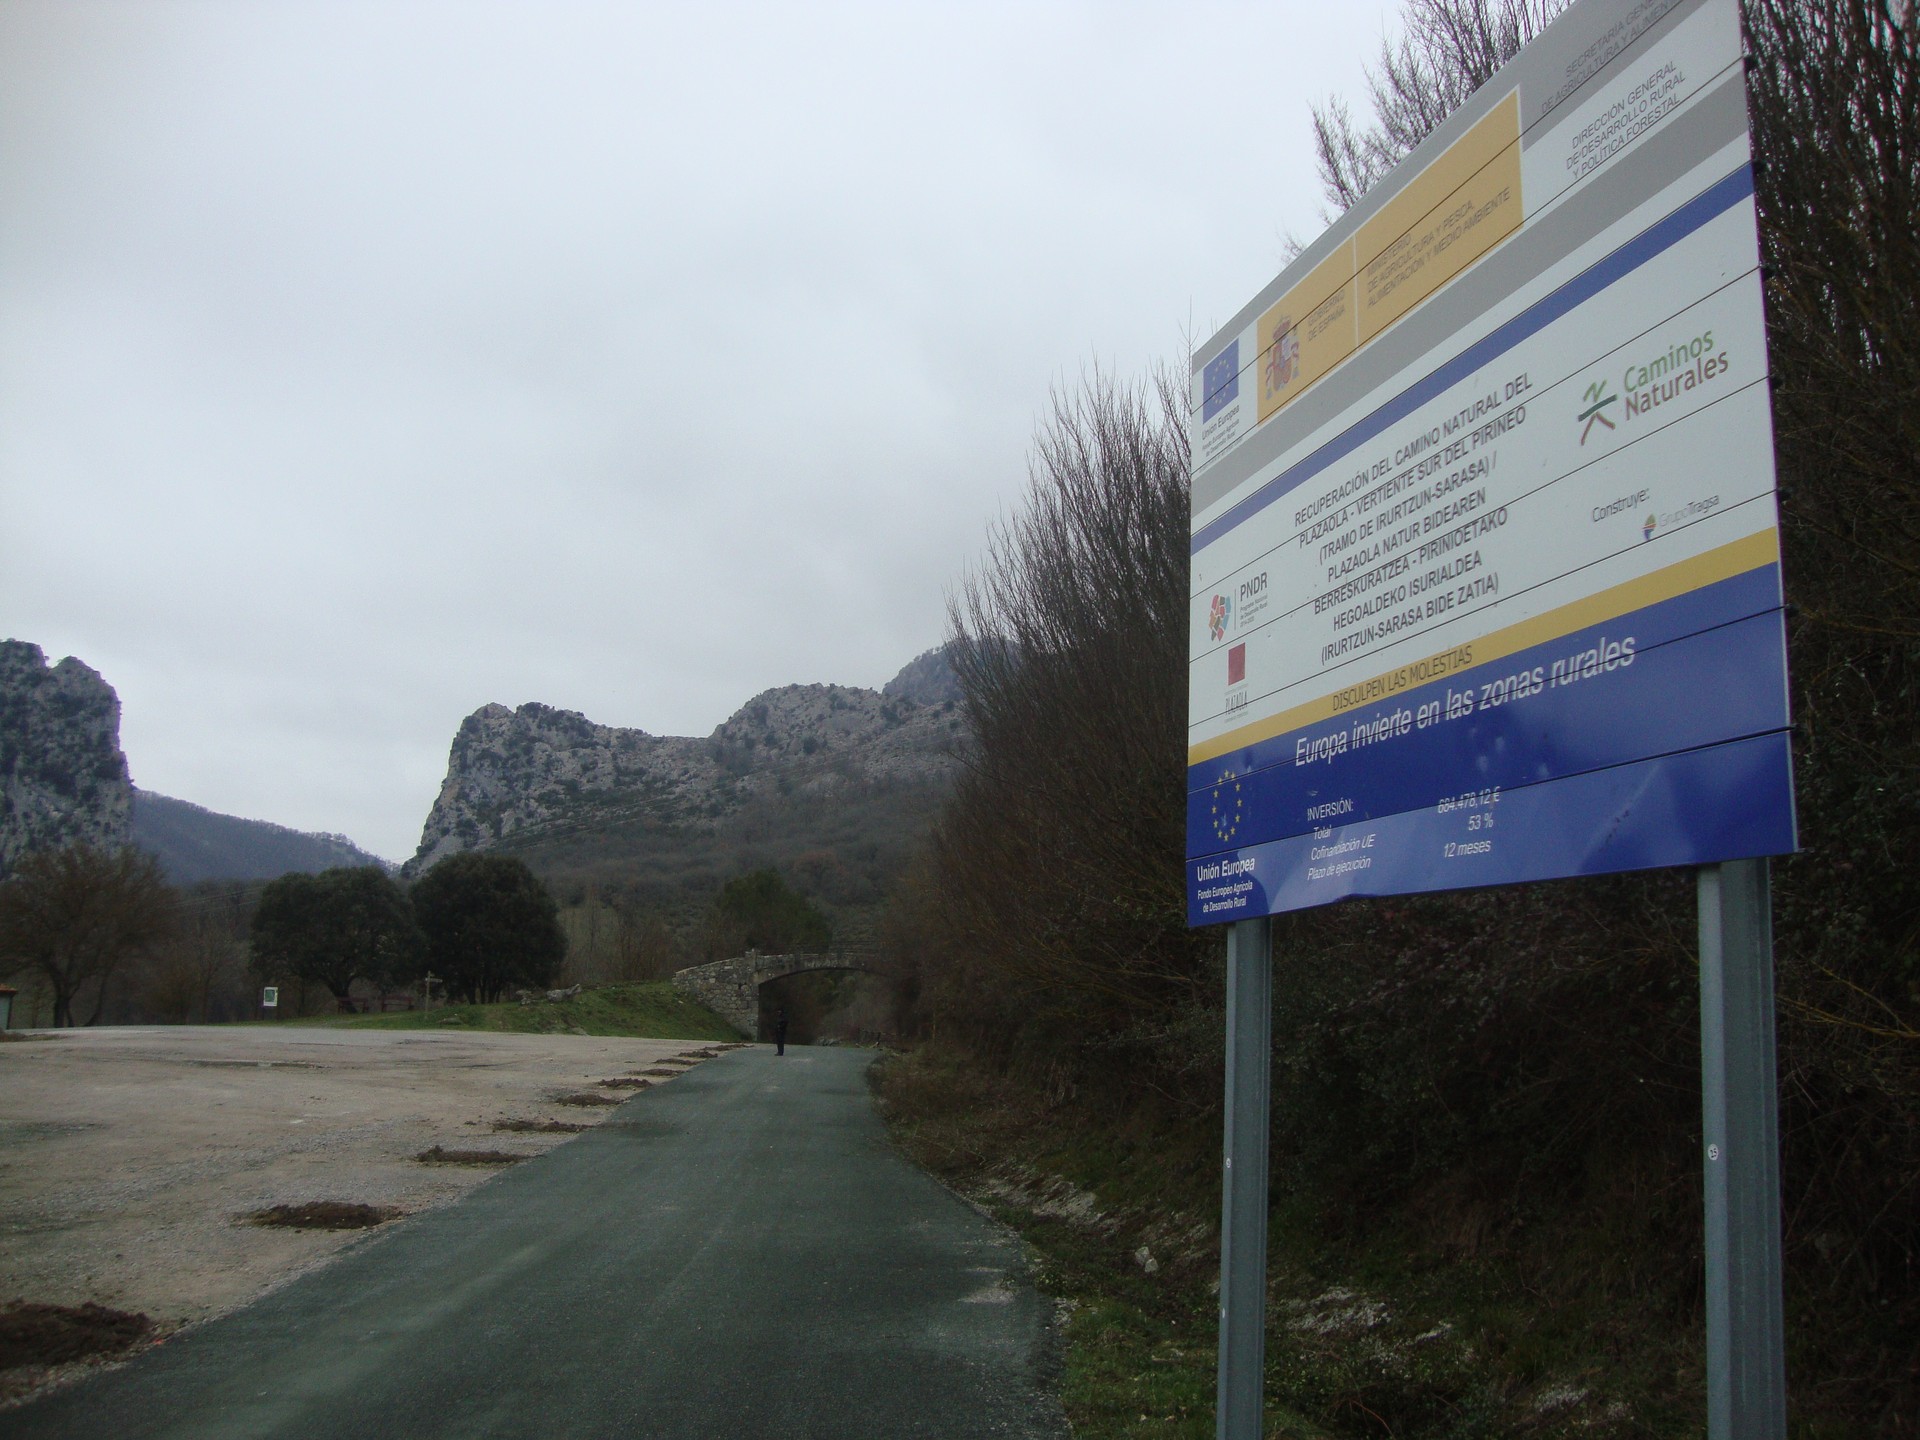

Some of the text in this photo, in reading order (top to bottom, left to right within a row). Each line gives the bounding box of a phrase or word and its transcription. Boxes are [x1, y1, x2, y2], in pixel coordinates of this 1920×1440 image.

[1541, 97, 1553, 114] DE
[1566, 71, 1686, 170] DE DESARROLLO RURAL
[1572, 60, 1677, 150] DIRECCIÓN GENERAL
[1572, 93, 1681, 180] Y POLÍTICA FORESTAL
[1624, 330, 1715, 393] Caminos
[1625, 351, 1729, 421] Naturales
[1295, 372, 1533, 527] RECUPERACIÓN DEL CAMINO NATURAL DEL
[1300, 509, 1349, 548] PLAZAOLA
[1356, 474, 1415, 515] VERTIENTE
[1417, 453, 1443, 481] SUR
[1445, 441, 1469, 465] DEL
[1471, 405, 1526, 451] PIRINEO
[1319, 530, 1357, 565] (TRAMO
[1359, 522, 1374, 541] DE
[1376, 456, 1489, 531] IRURTZUN-SARASA)
[1328, 487, 1486, 582] PLAZAOLA NATUR BIDEAREN
[1592, 488, 1650, 523] Construye:
[1240, 572, 1268, 602] PNDR
[1314, 556, 1411, 615] BERRESKURATZEA
[1419, 507, 1507, 564] PIRINIOETAKO
[1333, 550, 1482, 631] HEGOALDEKO ISURIALDEA
[1321, 572, 1499, 666] (IRURTZUN-SARASA BIDE ZATIA)
[1295, 636, 1636, 766] Europa invierte en las zonas rurales
[1333, 645, 1473, 712] DISCULPEN LAS MOLESTIAS
[1307, 797, 1354, 821] INVERSIÓN:
[1311, 812, 1493, 861] Cofinanciación UE 53 %
[1313, 824, 1333, 840] Total
[1197, 857, 1255, 882] Unión Europea
[1198, 888, 1211, 900] Fondo
[1212, 886, 1233, 897] Europeo
[1307, 840, 1491, 881] Plazo de ejecución 12 meses
[1202, 896, 1247, 913] de Desarrollo Rural
